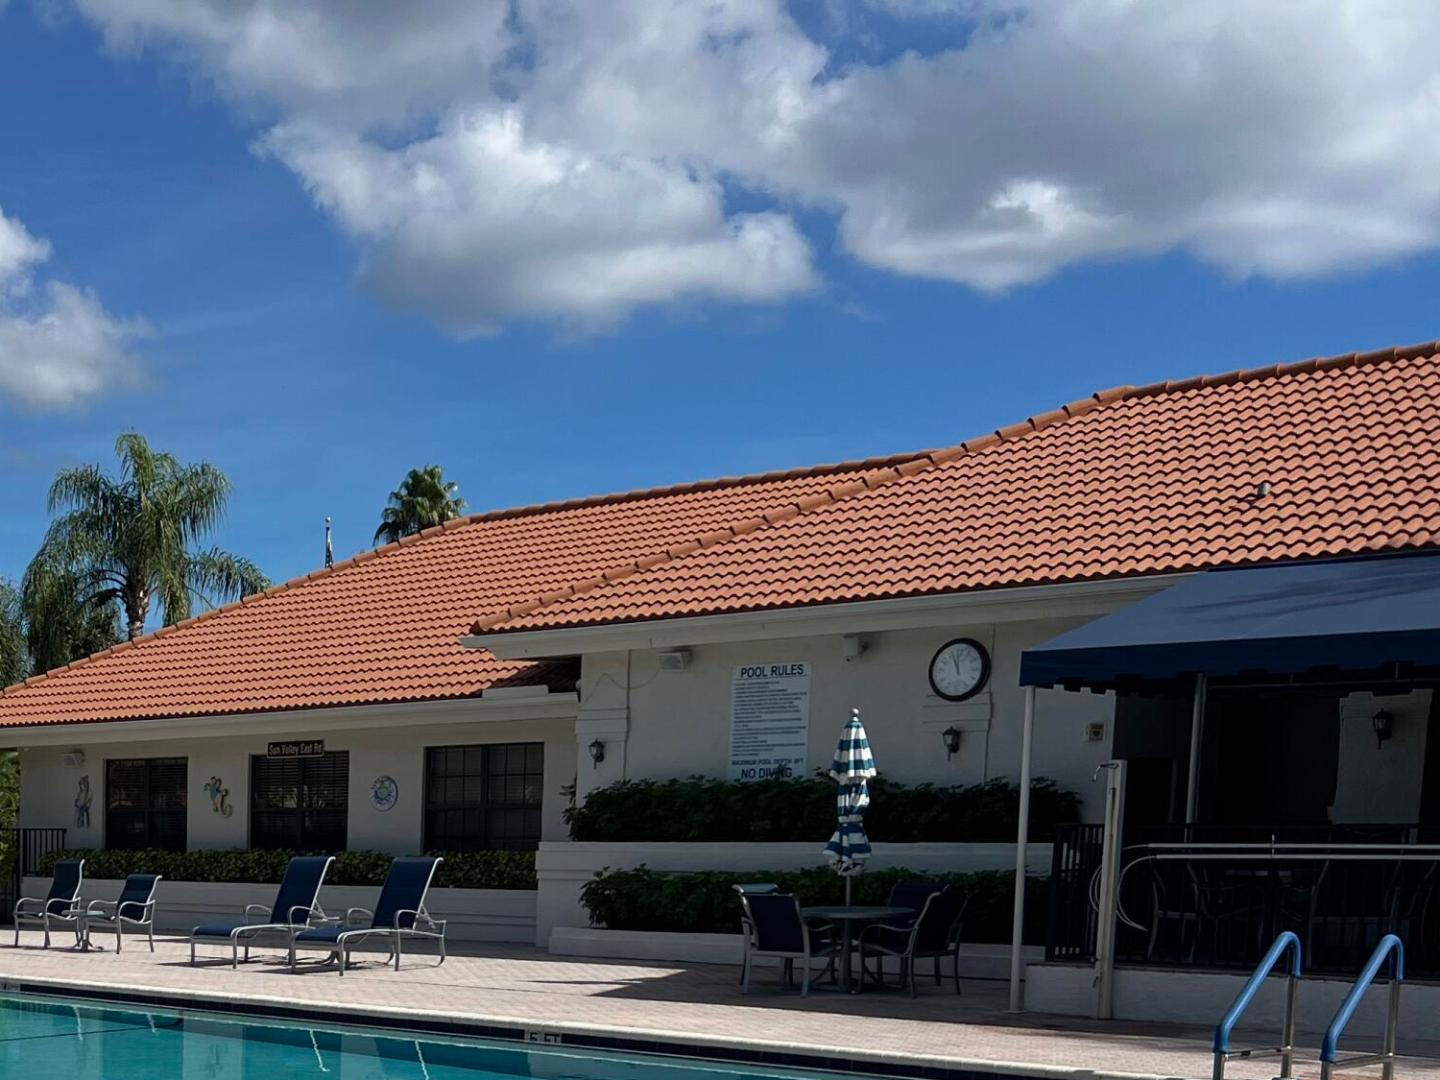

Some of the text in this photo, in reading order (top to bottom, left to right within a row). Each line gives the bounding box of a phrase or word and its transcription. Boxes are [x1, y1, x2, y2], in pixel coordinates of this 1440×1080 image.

[740, 664, 804, 679] POOL RULES
[281, 744, 299, 756] Valley
[741, 768, 756, 779] NO
[544, 1033, 560, 1043] FT
